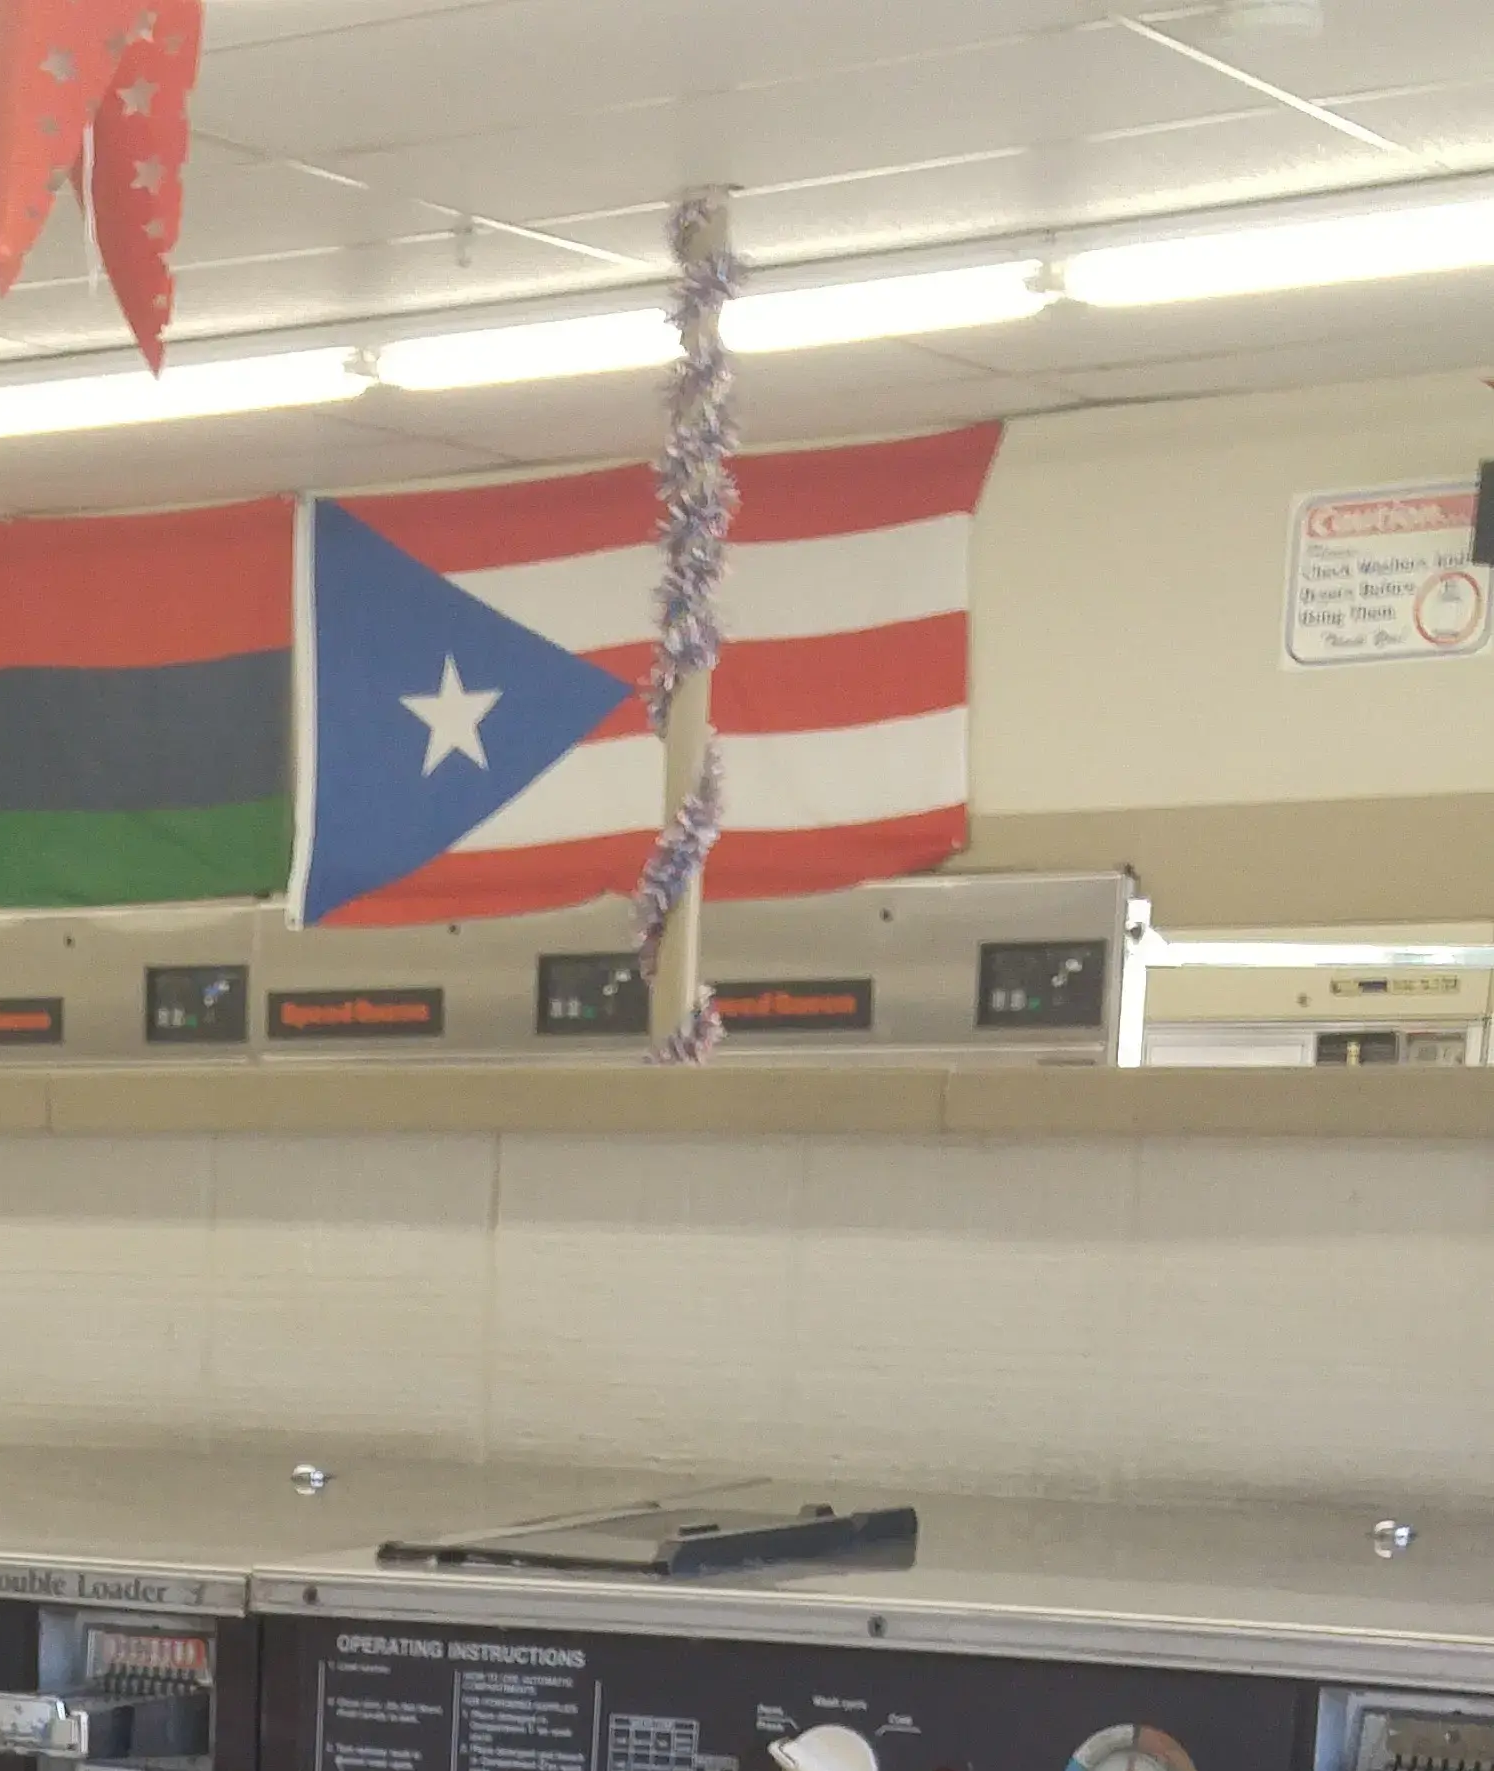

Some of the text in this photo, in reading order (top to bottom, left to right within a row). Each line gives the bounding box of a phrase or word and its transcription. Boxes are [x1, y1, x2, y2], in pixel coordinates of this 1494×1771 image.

[77, 1572, 169, 1603] Loader
[336, 1634, 587, 1669] OPERATING INSTRUCTIONS
